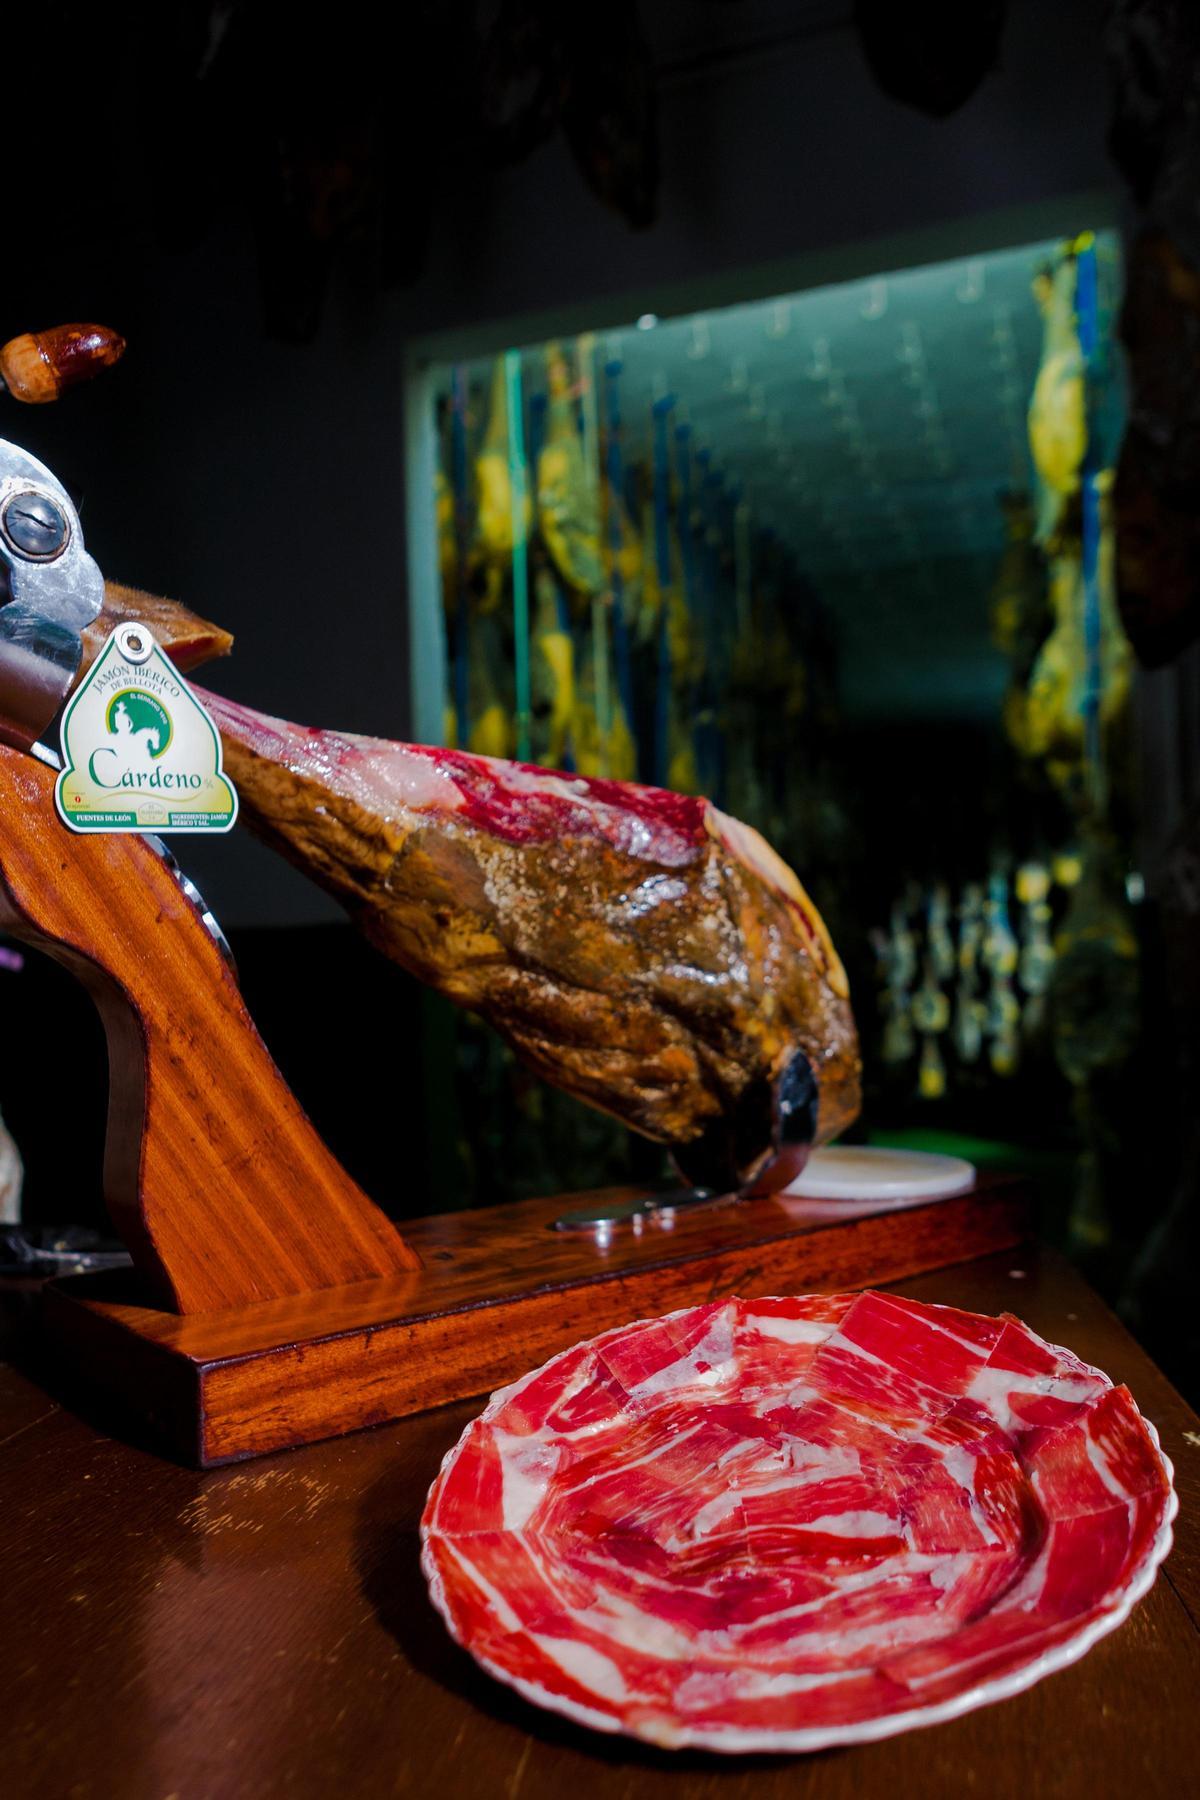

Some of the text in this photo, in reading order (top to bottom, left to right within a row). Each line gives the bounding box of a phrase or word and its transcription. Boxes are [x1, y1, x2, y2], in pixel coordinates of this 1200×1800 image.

[93, 665, 180, 697] JAMÓN IBÉRICO
[110, 677, 162, 695] DE BELLOTA
[88, 747, 202, 789] Cárdeno
[76, 813, 132, 822] FUENTES DE LEÓN
